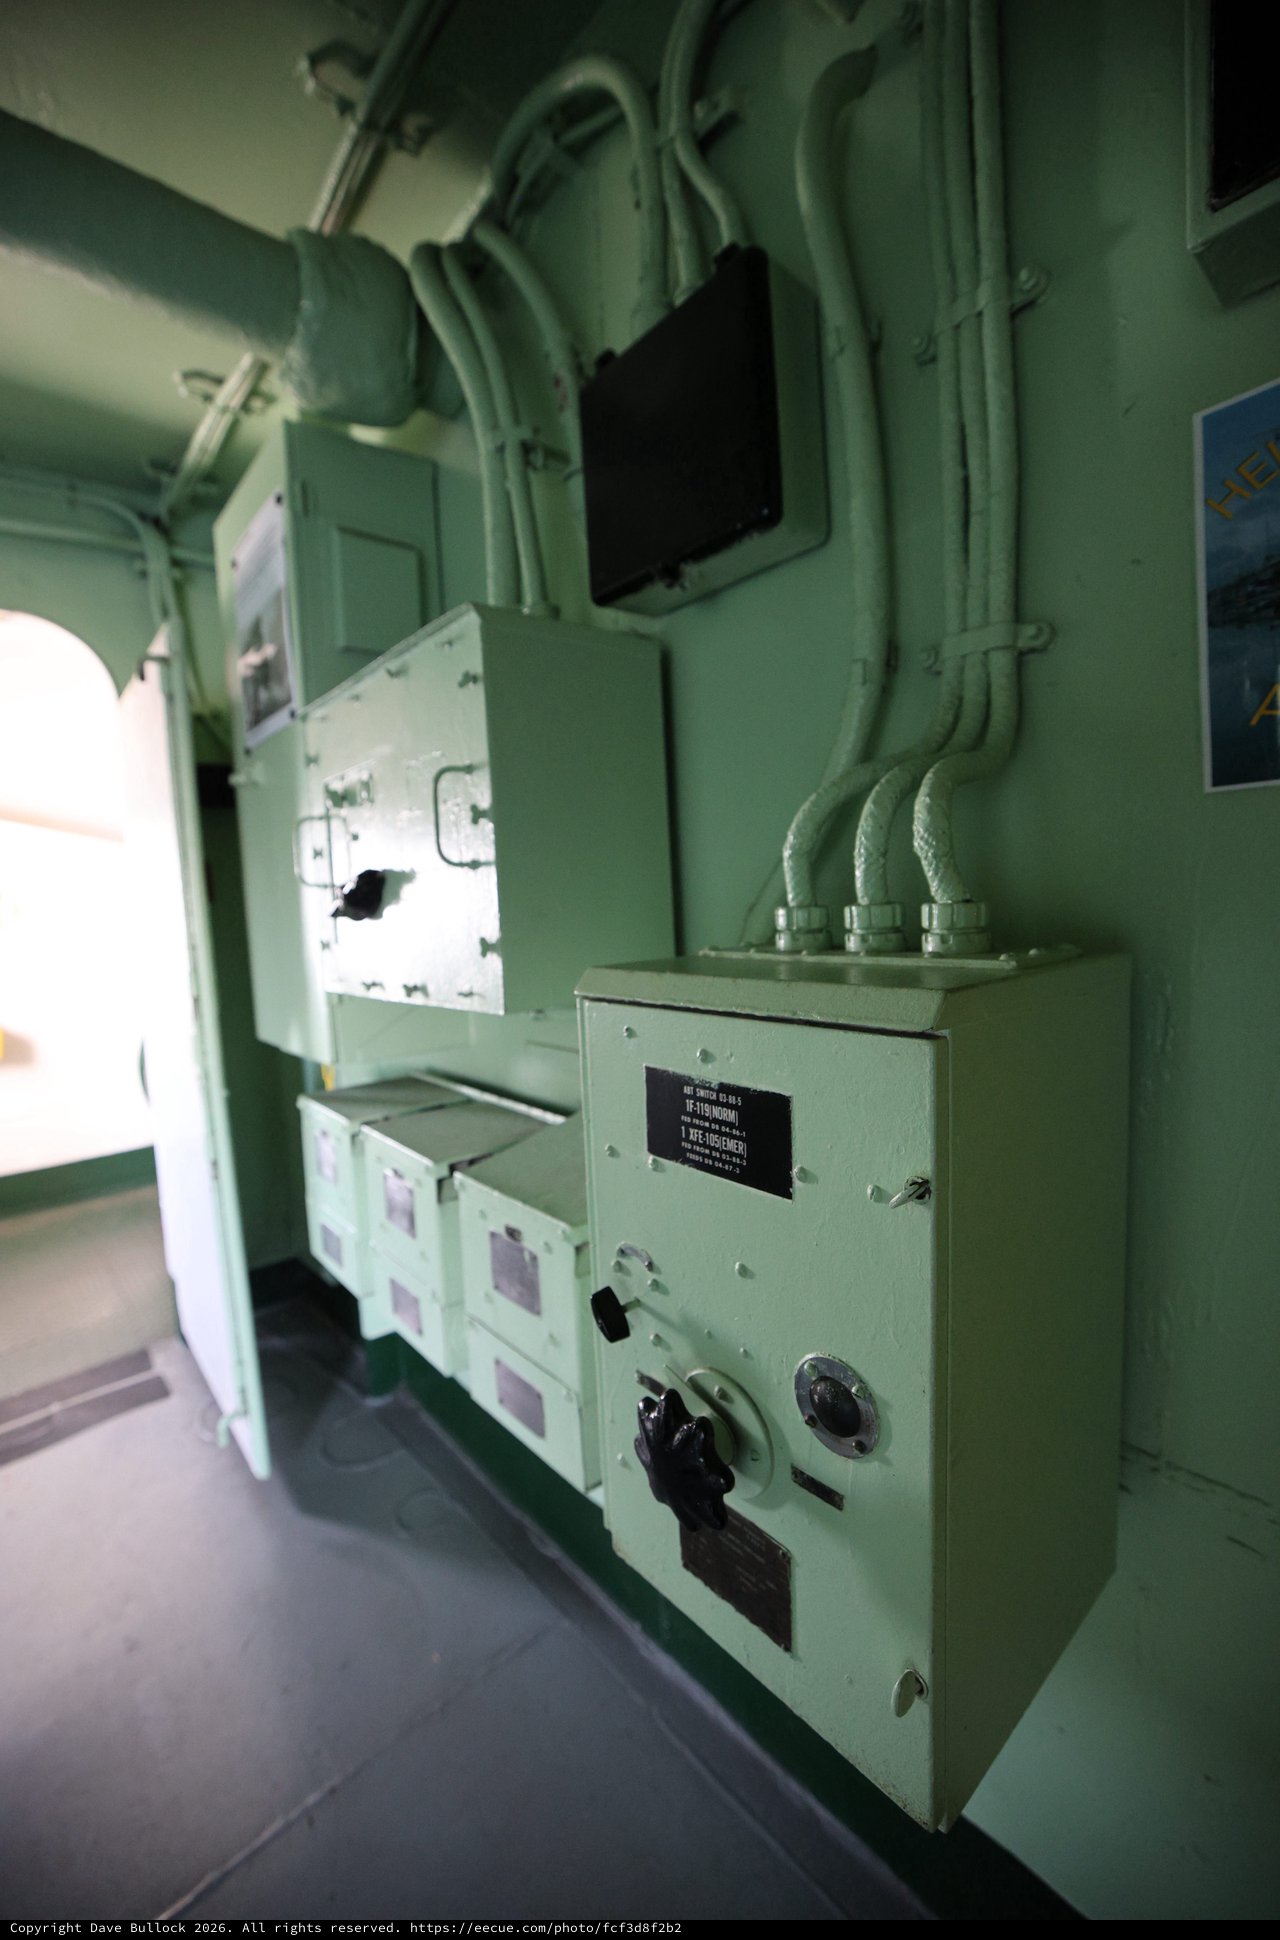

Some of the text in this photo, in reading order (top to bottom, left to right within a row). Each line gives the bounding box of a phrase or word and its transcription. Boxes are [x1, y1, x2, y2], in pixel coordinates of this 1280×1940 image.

[683, 1085, 694, 1095] ABT
[696, 1088, 717, 1100] SWITCH
[681, 1115, 692, 1123] FED
[692, 1118, 710, 1128] FROM
[681, 1125, 686, 1139] 1
[681, 1141, 692, 1150] FED
[693, 1145, 711, 1155] FROM
[686, 1152, 703, 1163] FEEDS
